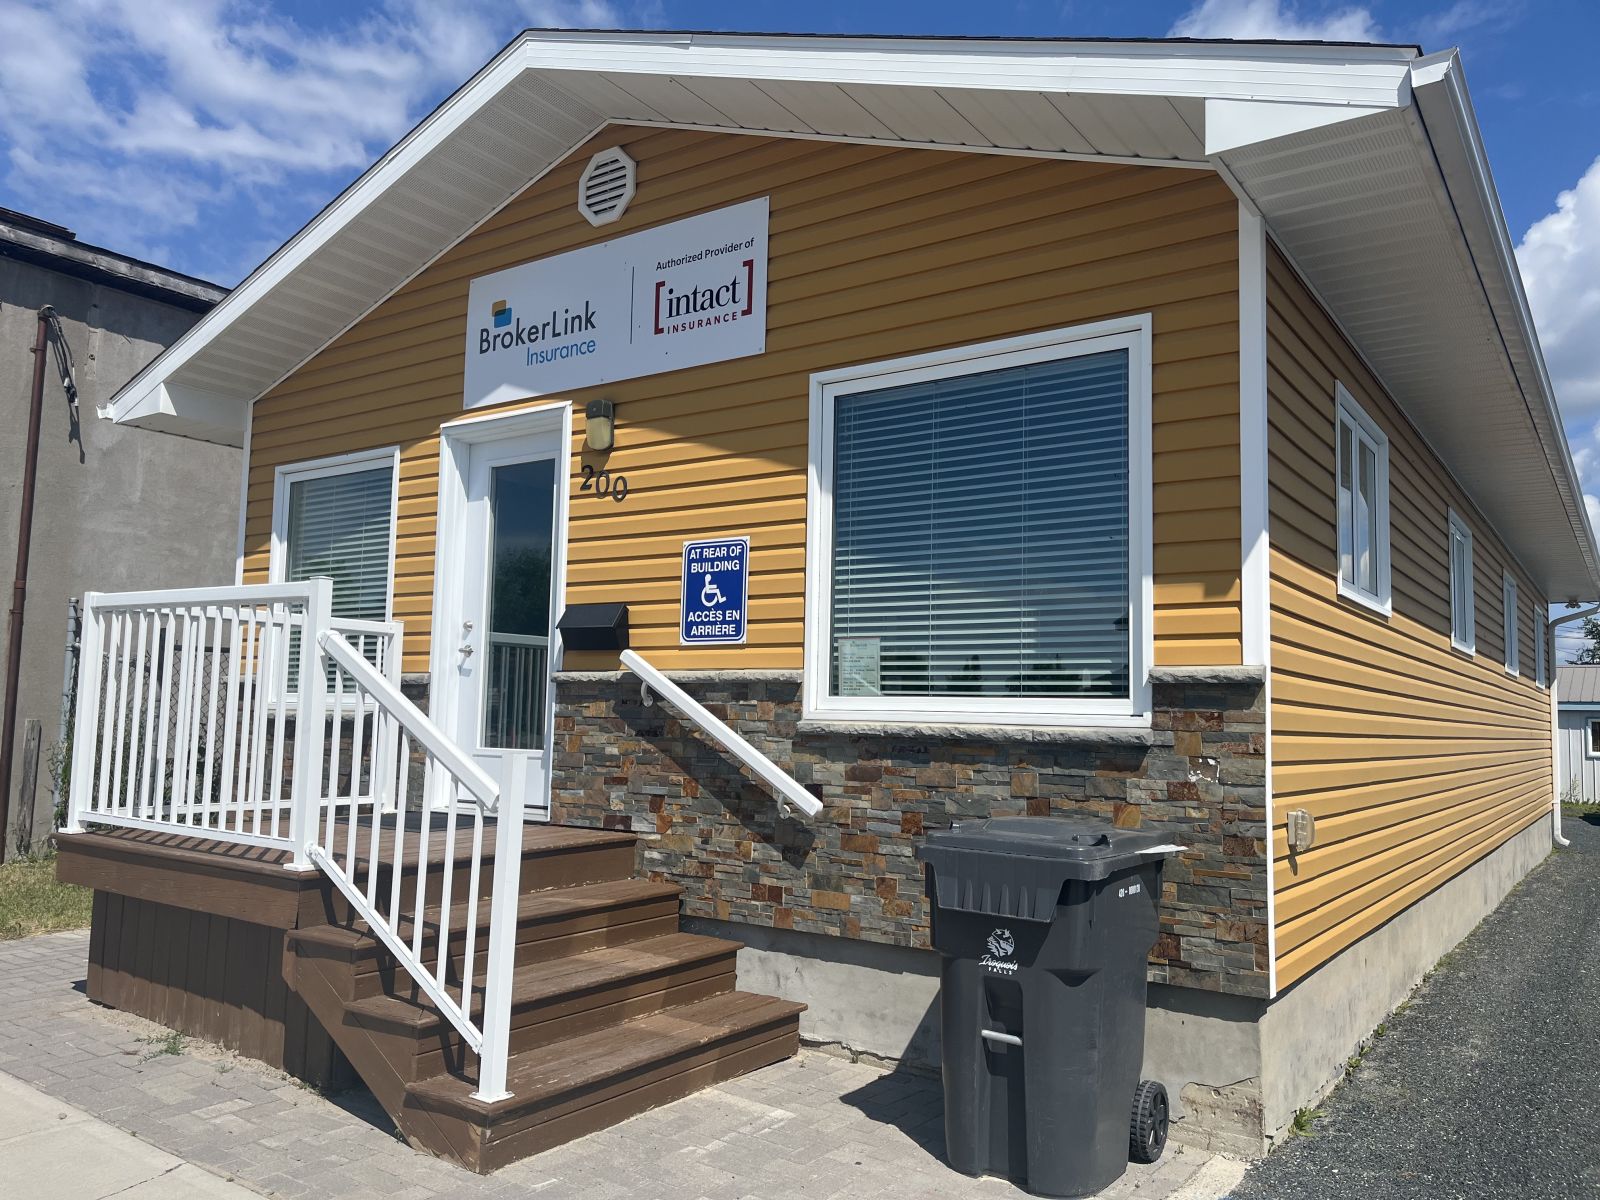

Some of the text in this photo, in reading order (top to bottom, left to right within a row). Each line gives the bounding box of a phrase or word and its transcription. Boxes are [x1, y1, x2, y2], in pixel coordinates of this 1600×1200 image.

[655, 237, 755, 271] Authorized Provider of
[666, 275, 741, 319] intact
[479, 300, 597, 355] BrokerLink
[667, 311, 738, 335] INSURANCE
[526, 339, 596, 366] Insurance
[579, 464, 628, 503] 200
[689, 545, 743, 560] AT REAR OF
[690, 560, 740, 573] BUILDING
[687, 608, 740, 622] ACCÈS EN
[690, 622, 736, 636] ARRIÈRE
